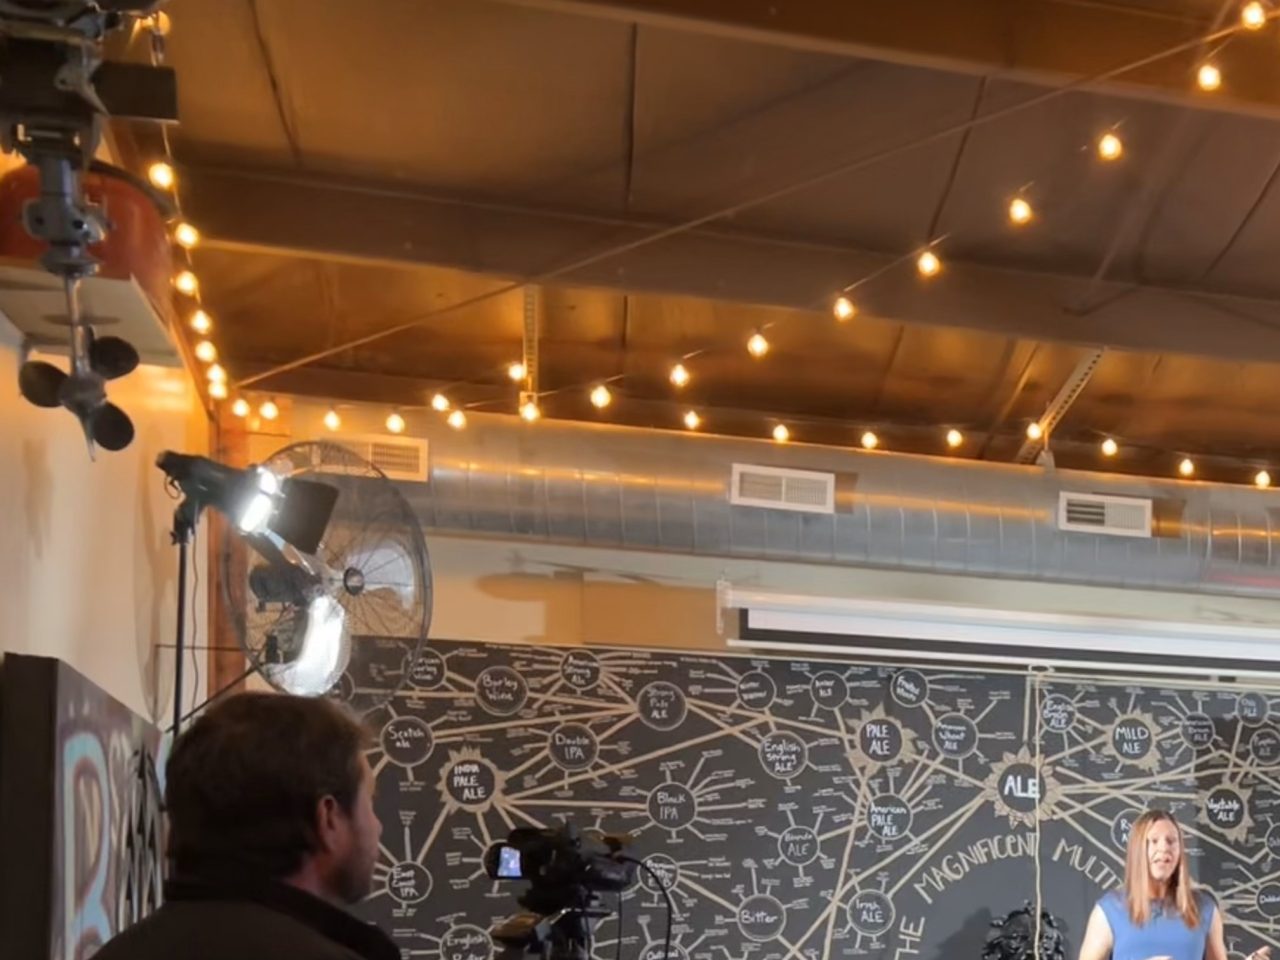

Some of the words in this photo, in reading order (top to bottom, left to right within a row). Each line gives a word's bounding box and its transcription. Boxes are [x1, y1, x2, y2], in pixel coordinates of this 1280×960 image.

[865, 723, 890, 738] PALE
[1114, 727, 1149, 741] MILD
[564, 746, 585, 760] IPA
[764, 738, 801, 756] English
[868, 740, 891, 755] ALE
[1122, 741, 1142, 754] ALE
[454, 764, 480, 775] INDIA
[453, 775, 479, 788] PALE
[1003, 774, 1041, 799] ALE
[463, 786, 487, 801] ALE
[657, 791, 686, 805] Black
[660, 806, 679, 820] IPA
[870, 801, 908, 815] American
[871, 814, 894, 827] PALE
[1217, 811, 1235, 822] ALE
[882, 825, 898, 837] ALE
[786, 842, 811, 857] ALE
[740, 910, 779, 925] Bitter
[860, 910, 886, 924] ALE
